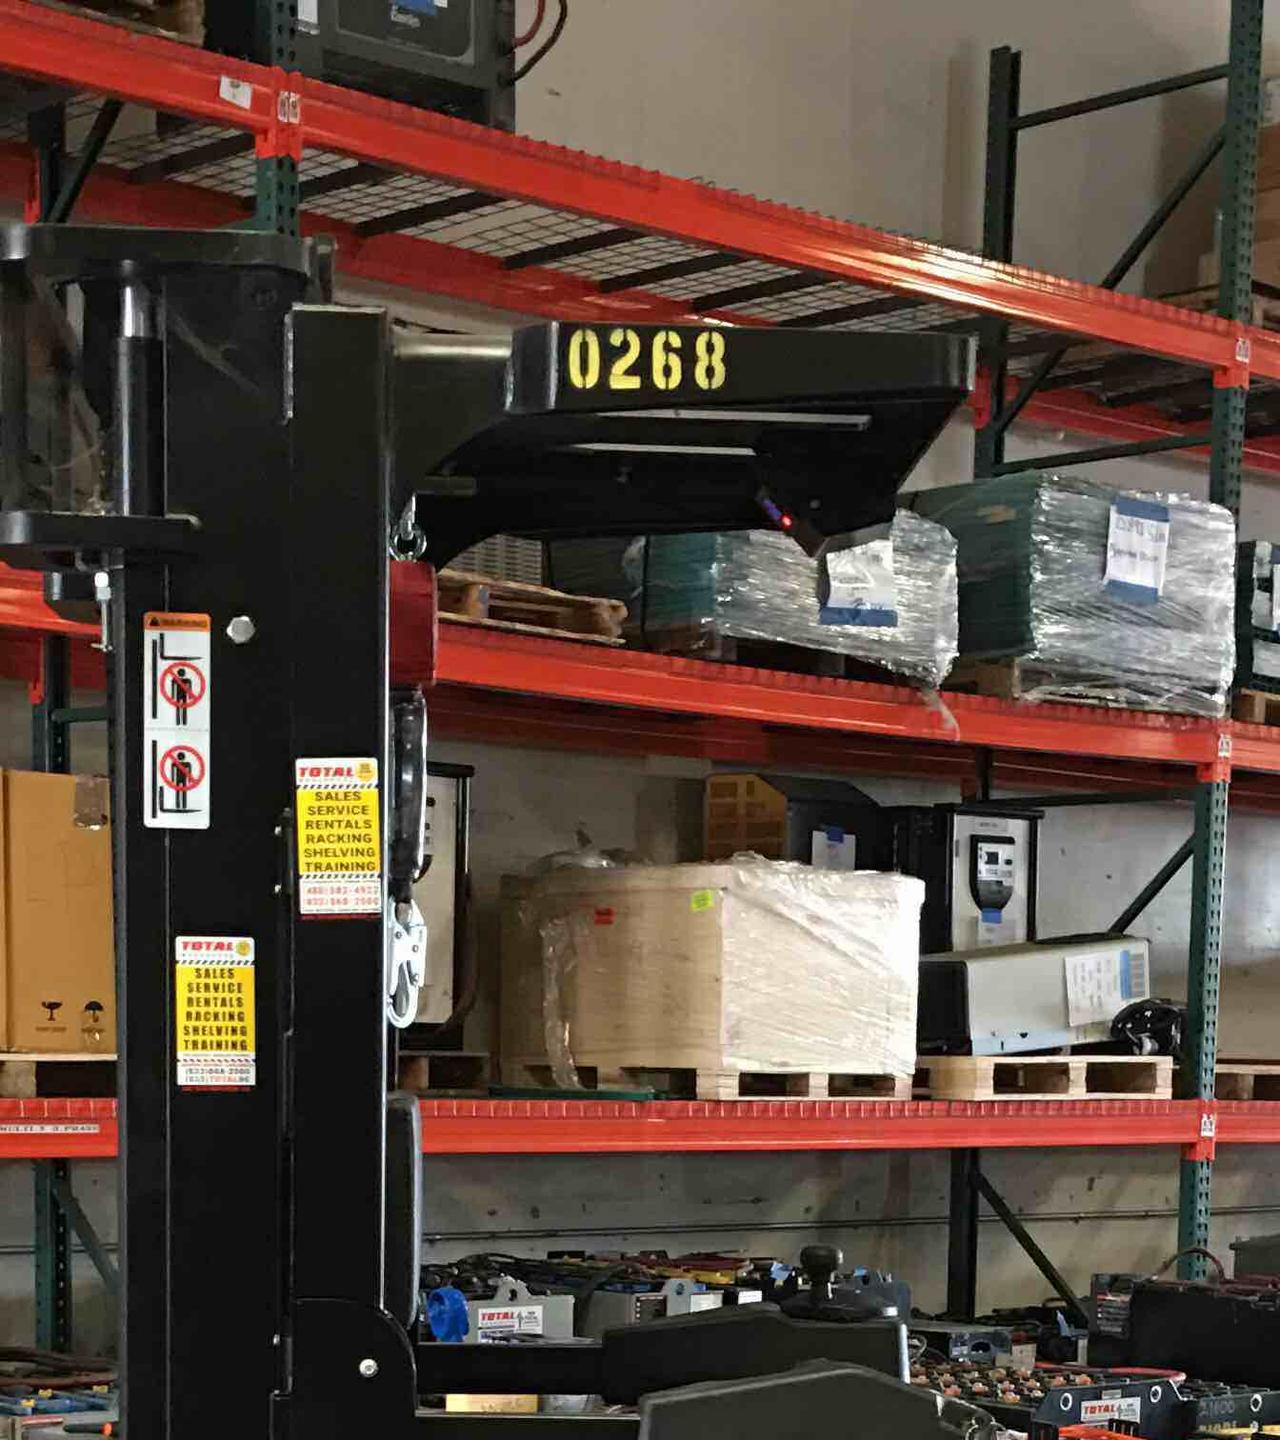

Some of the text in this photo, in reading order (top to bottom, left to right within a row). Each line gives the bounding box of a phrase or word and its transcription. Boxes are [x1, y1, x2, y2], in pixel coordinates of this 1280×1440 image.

[568, 328, 726, 391] 0268
[298, 767, 355, 778] TOTAL
[315, 791, 362, 802] SALES
[307, 805, 370, 816] SERVICE
[305, 819, 373, 830] RENTALS
[305, 833, 373, 844] RACKING
[304, 847, 376, 858] SHELVING
[304, 861, 376, 872] TRAINING
[181, 941, 235, 951] TOTAL
[194, 967, 235, 979] SALES
[187, 982, 243, 993] SERVICE
[186, 996, 244, 1008] RENTALS
[185, 1010, 246, 1022] RACKING
[183, 1025, 248, 1036] SHELVING
[183, 1039, 248, 1051] TRAINING
[480, 1311, 516, 1322] TOTAL
[1084, 1400, 1117, 1415] TOTAL
